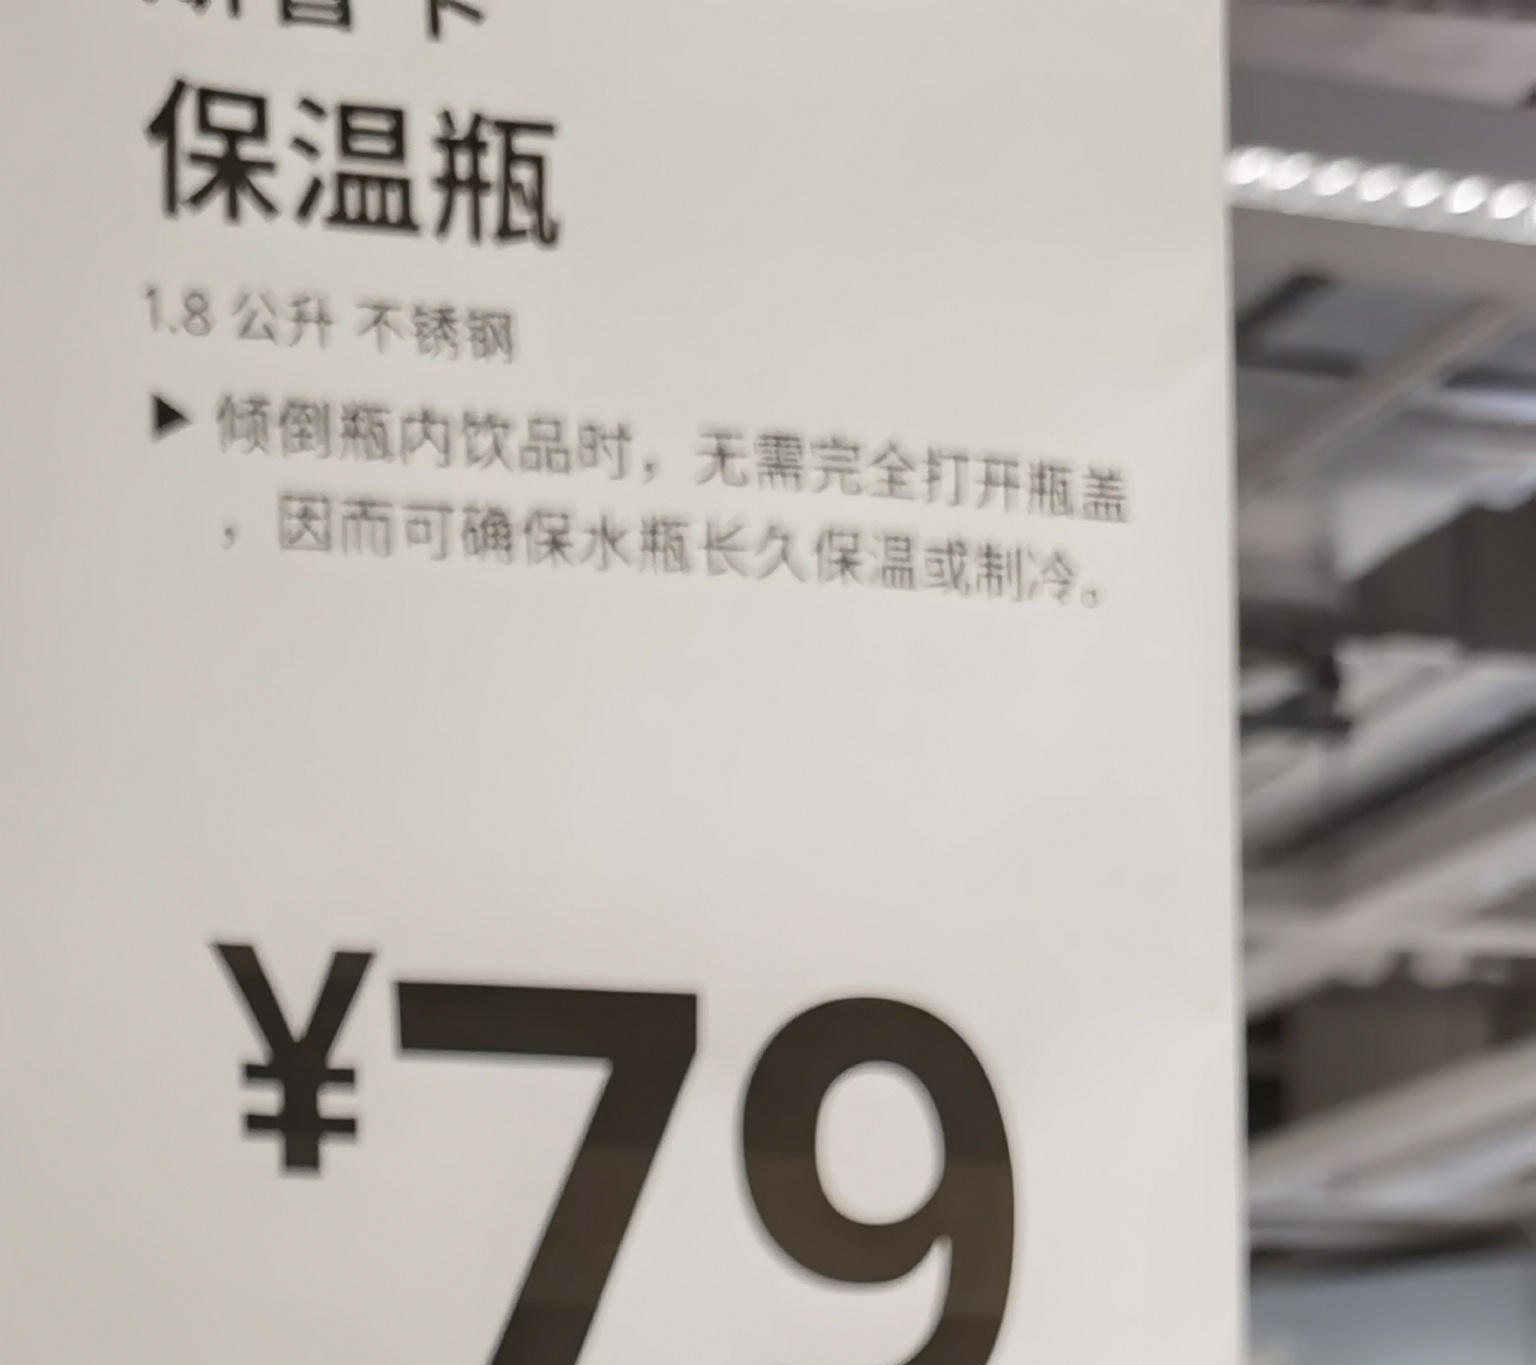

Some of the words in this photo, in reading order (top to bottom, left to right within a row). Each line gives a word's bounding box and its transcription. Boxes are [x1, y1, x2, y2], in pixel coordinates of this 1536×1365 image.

[146, 76, 562, 248] 保温瓶
[144, 286, 213, 338] 1.8
[230, 290, 334, 350] 公升
[356, 300, 518, 363] 不锈钢
